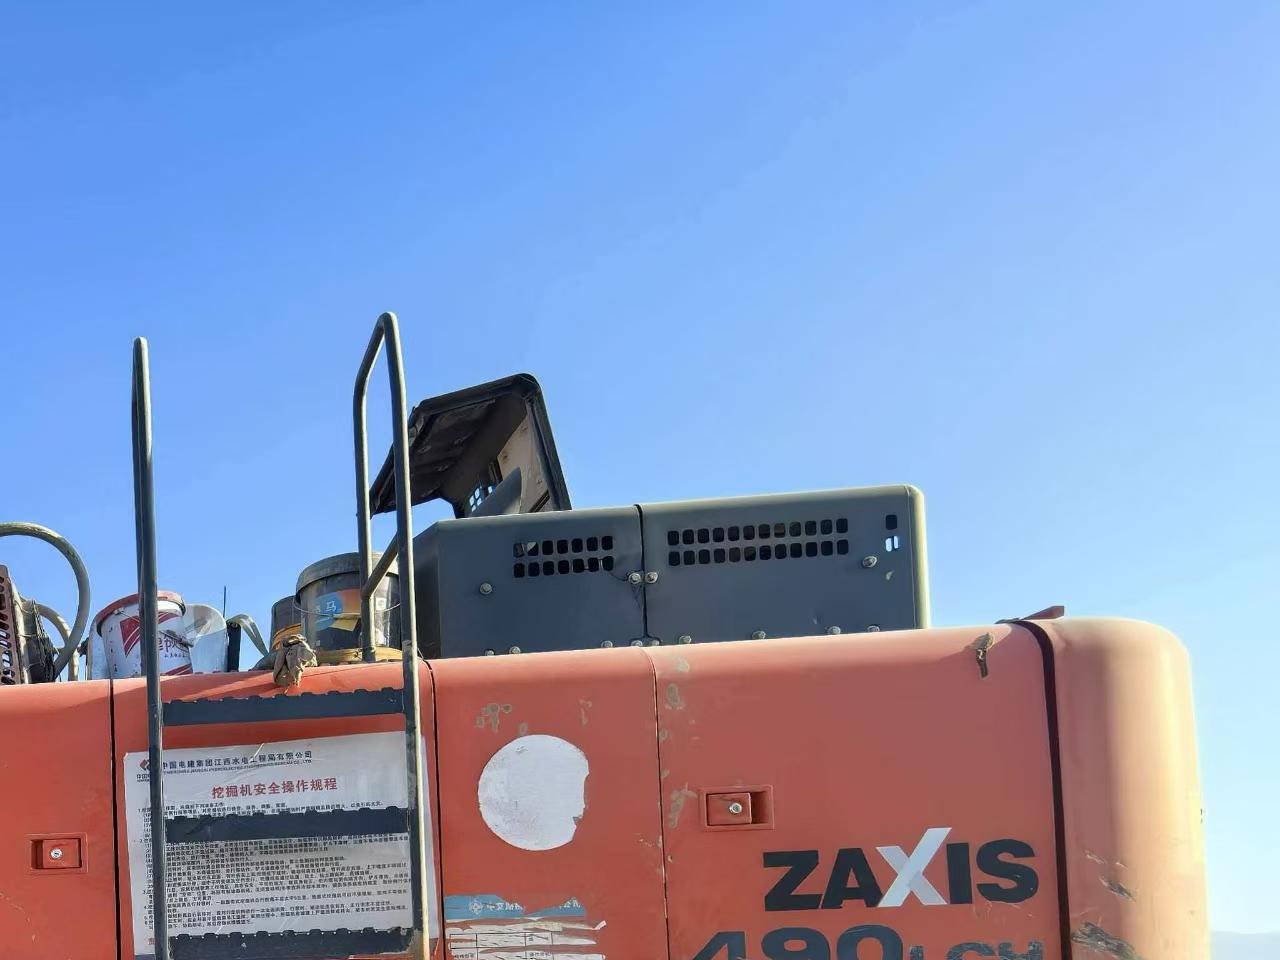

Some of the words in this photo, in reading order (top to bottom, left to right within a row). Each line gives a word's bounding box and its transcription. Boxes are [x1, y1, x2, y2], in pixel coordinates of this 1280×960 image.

[212, 777, 338, 799] 挖掘机安全操作规程
[762, 827, 1040, 912] ZAXIS
